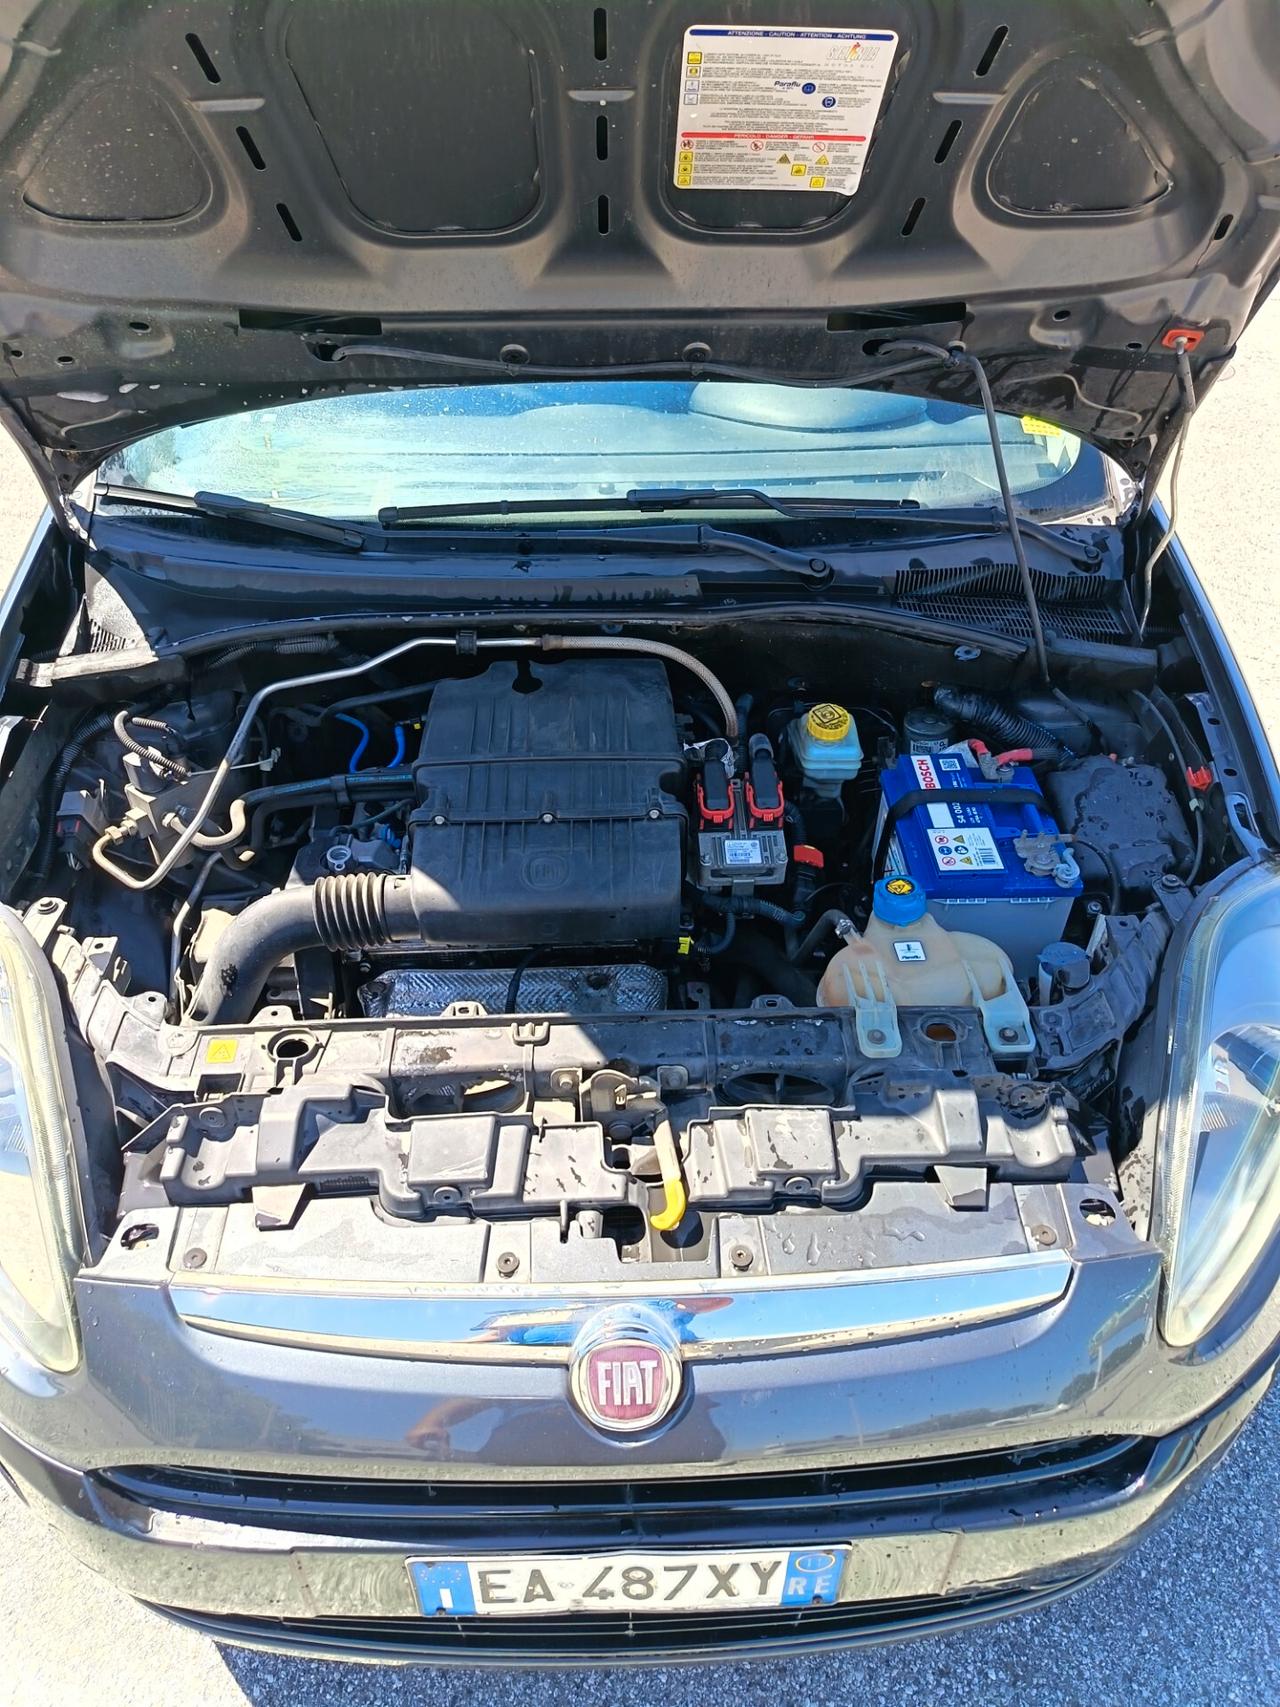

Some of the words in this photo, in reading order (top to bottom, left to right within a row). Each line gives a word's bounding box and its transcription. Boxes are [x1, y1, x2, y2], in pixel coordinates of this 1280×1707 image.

[774, 80, 801, 88] Paraflu
[916, 759, 937, 789] BOSCH
[597, 1360, 659, 1406] FIAT
[439, 1588, 454, 1609] I
[478, 1568, 555, 1604] EA
[582, 1560, 782, 1604] 487XY
[787, 1574, 833, 1597] RE
